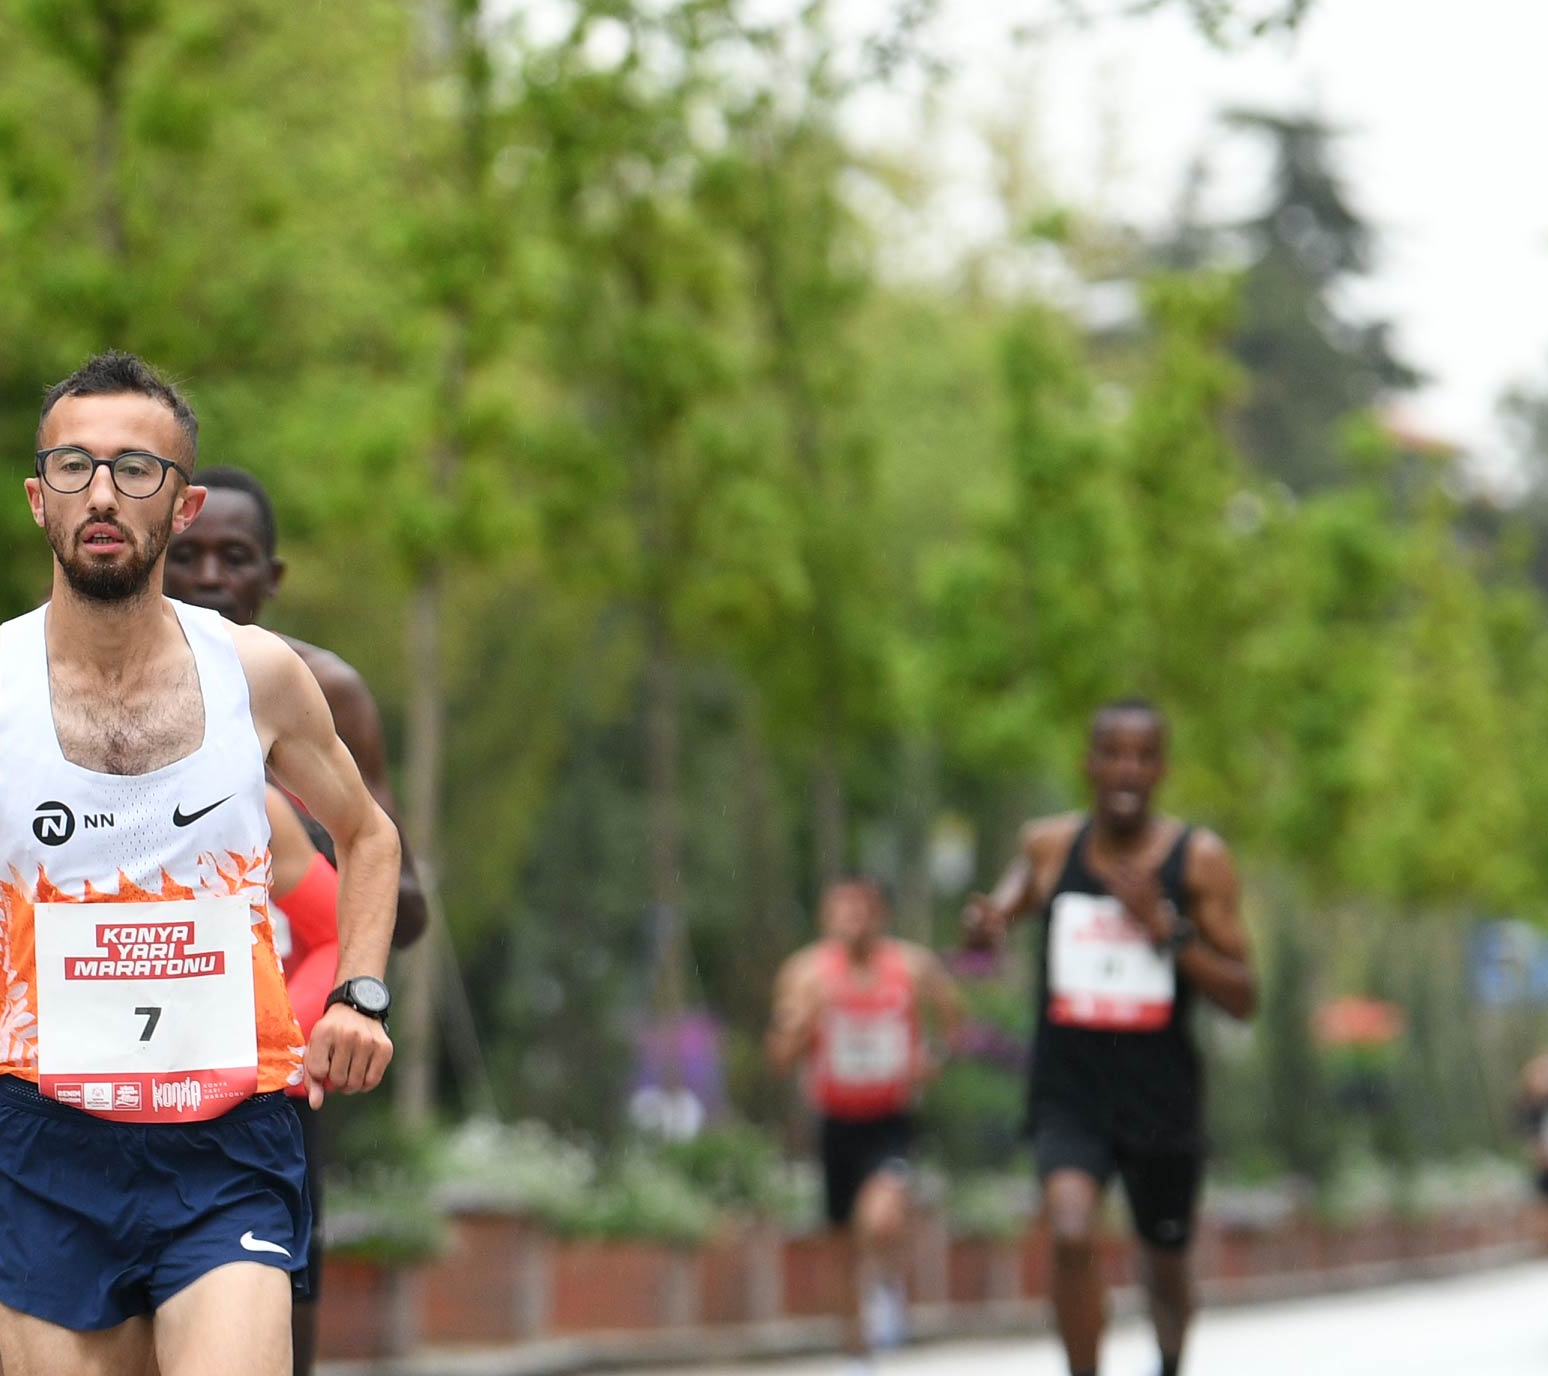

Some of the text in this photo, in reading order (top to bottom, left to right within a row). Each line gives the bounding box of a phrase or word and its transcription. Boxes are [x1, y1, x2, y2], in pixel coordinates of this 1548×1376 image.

[84, 813, 115, 829] NN
[103, 926, 188, 944] KONYA
[117, 943, 176, 959] YARI
[74, 956, 215, 976] MARATONU
[134, 1007, 162, 1042] 7
